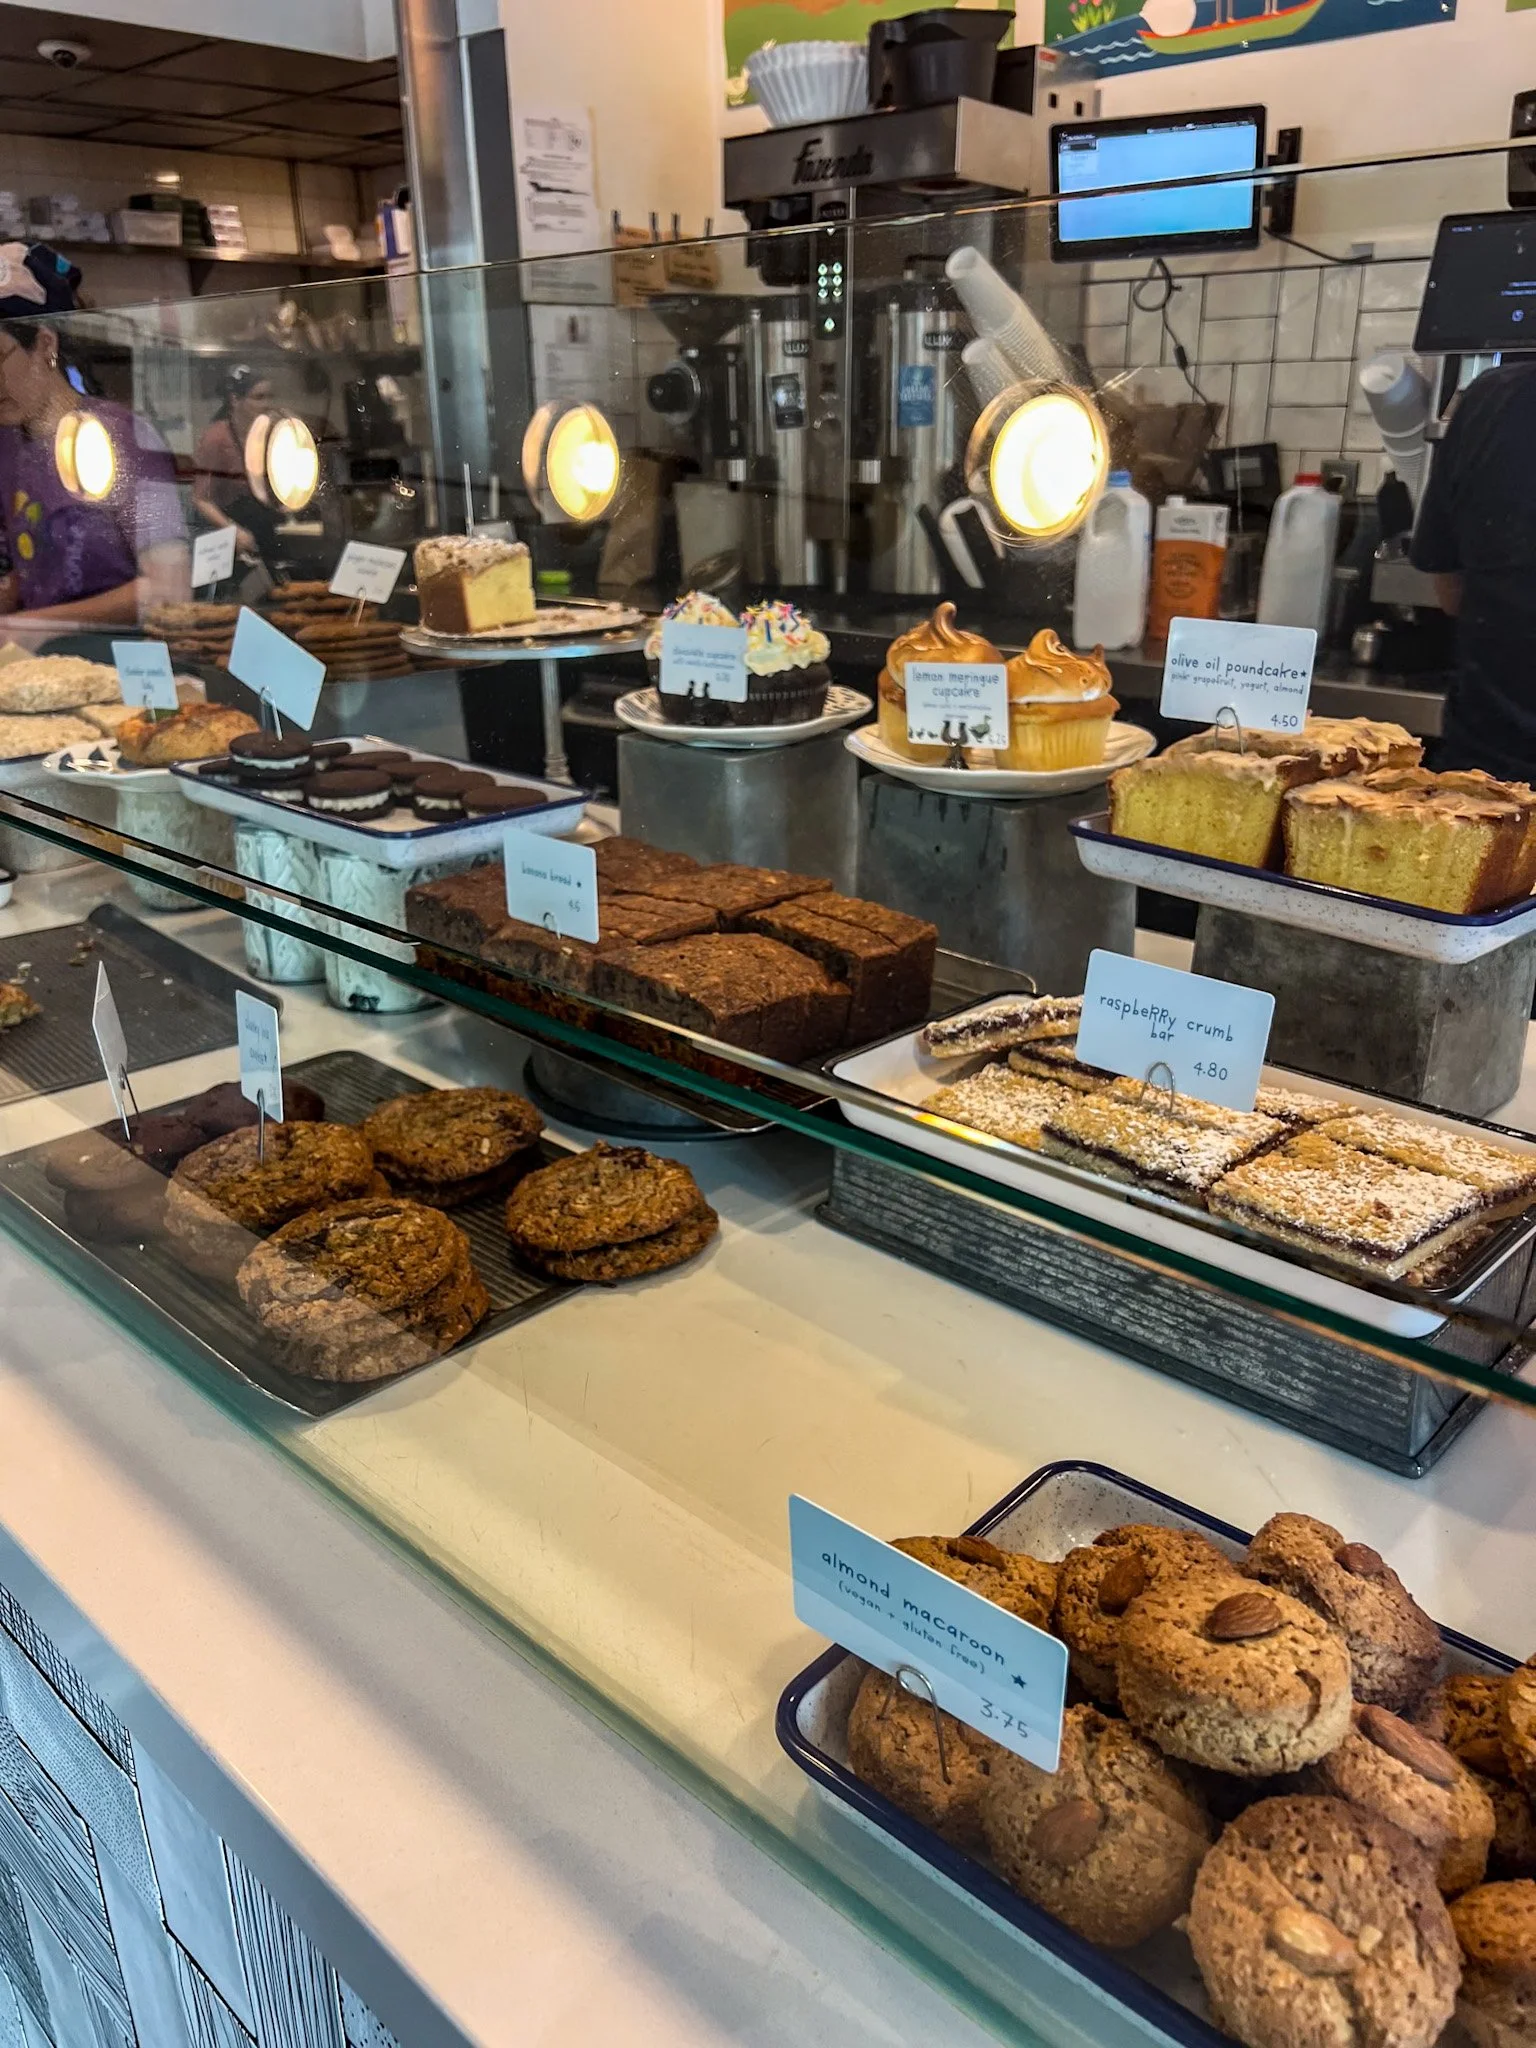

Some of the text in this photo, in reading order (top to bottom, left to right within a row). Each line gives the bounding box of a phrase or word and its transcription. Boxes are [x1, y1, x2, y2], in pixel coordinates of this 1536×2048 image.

[912, 665, 999, 687] lemon meringue
[1170, 653, 1299, 679] olive oil poundcake
[932, 683, 980, 703] cupcake
[1273, 684, 1304, 695] almond
[1271, 714, 1298, 727] 4.50
[1150, 1022, 1175, 1042] bar
[1187, 1020, 1233, 1042] crumb
[1193, 1062, 1228, 1081] 4.80
[822, 1551, 1006, 1666] almond macaroon
[838, 1581, 881, 1612] (vegan
[903, 1618, 942, 1648] gluten
[950, 1645, 986, 1675] free)
[980, 1697, 1029, 1739] 3.75
